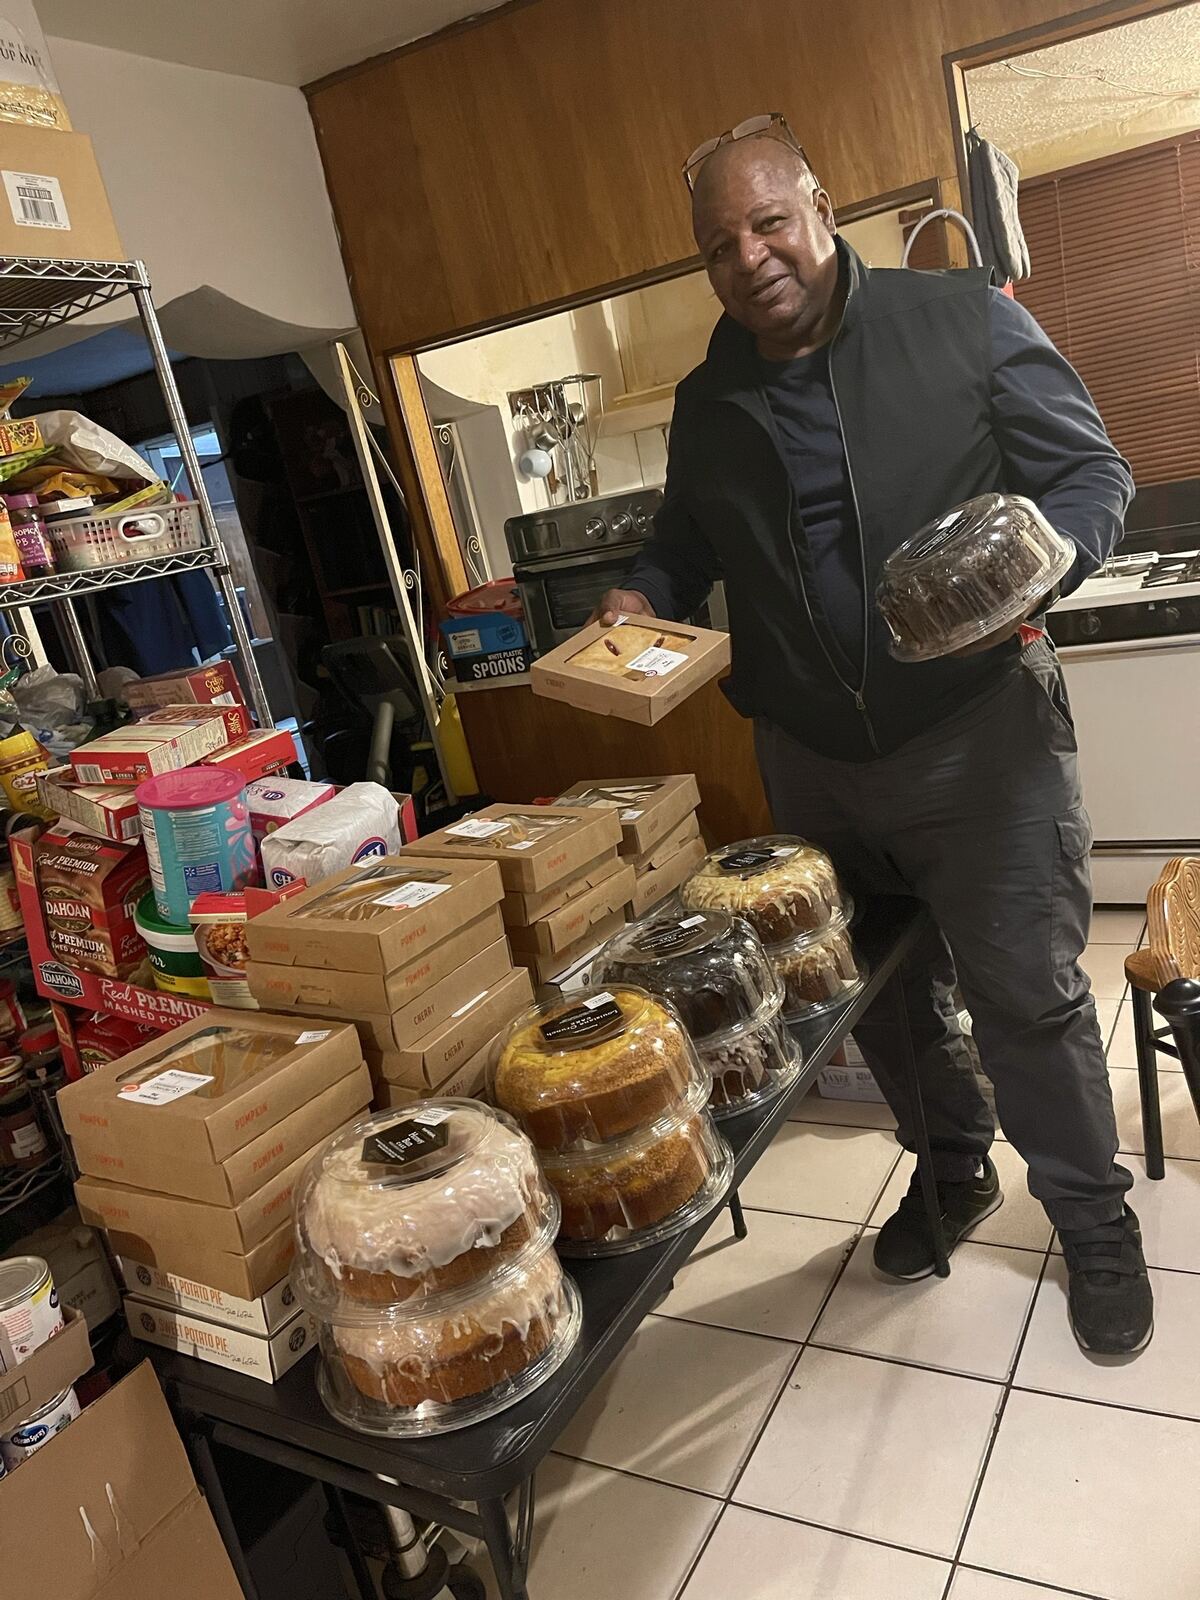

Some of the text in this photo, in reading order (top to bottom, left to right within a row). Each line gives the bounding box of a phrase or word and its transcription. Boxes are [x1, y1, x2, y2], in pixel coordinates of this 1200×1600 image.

[0, 47, 16, 61] UP
[487, 649, 524, 661] WHITE PLASTIC
[472, 656, 526, 679] SPOONS
[65, 840, 101, 852] IDAHOAN
[57, 855, 99, 872] PREMIUM
[46, 901, 91, 919] DAHOAN
[57, 932, 105, 953] PREMIUM
[401, 924, 427, 947] PUMPKIN
[43, 971, 80, 988] IDAHOAN
[405, 962, 431, 988] PUMPKIN
[98, 978, 133, 1002] Real
[134, 991, 211, 1019] PREMIU
[104, 1000, 155, 1021] MASHED
[413, 1004, 435, 1026] CHERRY
[579, 1009, 618, 1026] Louisiana
[546, 1023, 578, 1037] Crunch
[444, 1040, 465, 1062] CHERRY
[234, 1102, 268, 1130] PUMPKIN
[253, 1142, 285, 1172] PUMPKIN
[262, 1187, 292, 1217] PUMPKIN
[154, 1270, 180, 1296] SWEET
[179, 1278, 208, 1300] POTATO
[209, 1289, 223, 1306] PIE
[158, 1318, 229, 1352] SWEET POTATO PIE
[13, 1427, 47, 1446] Ocean Spray
